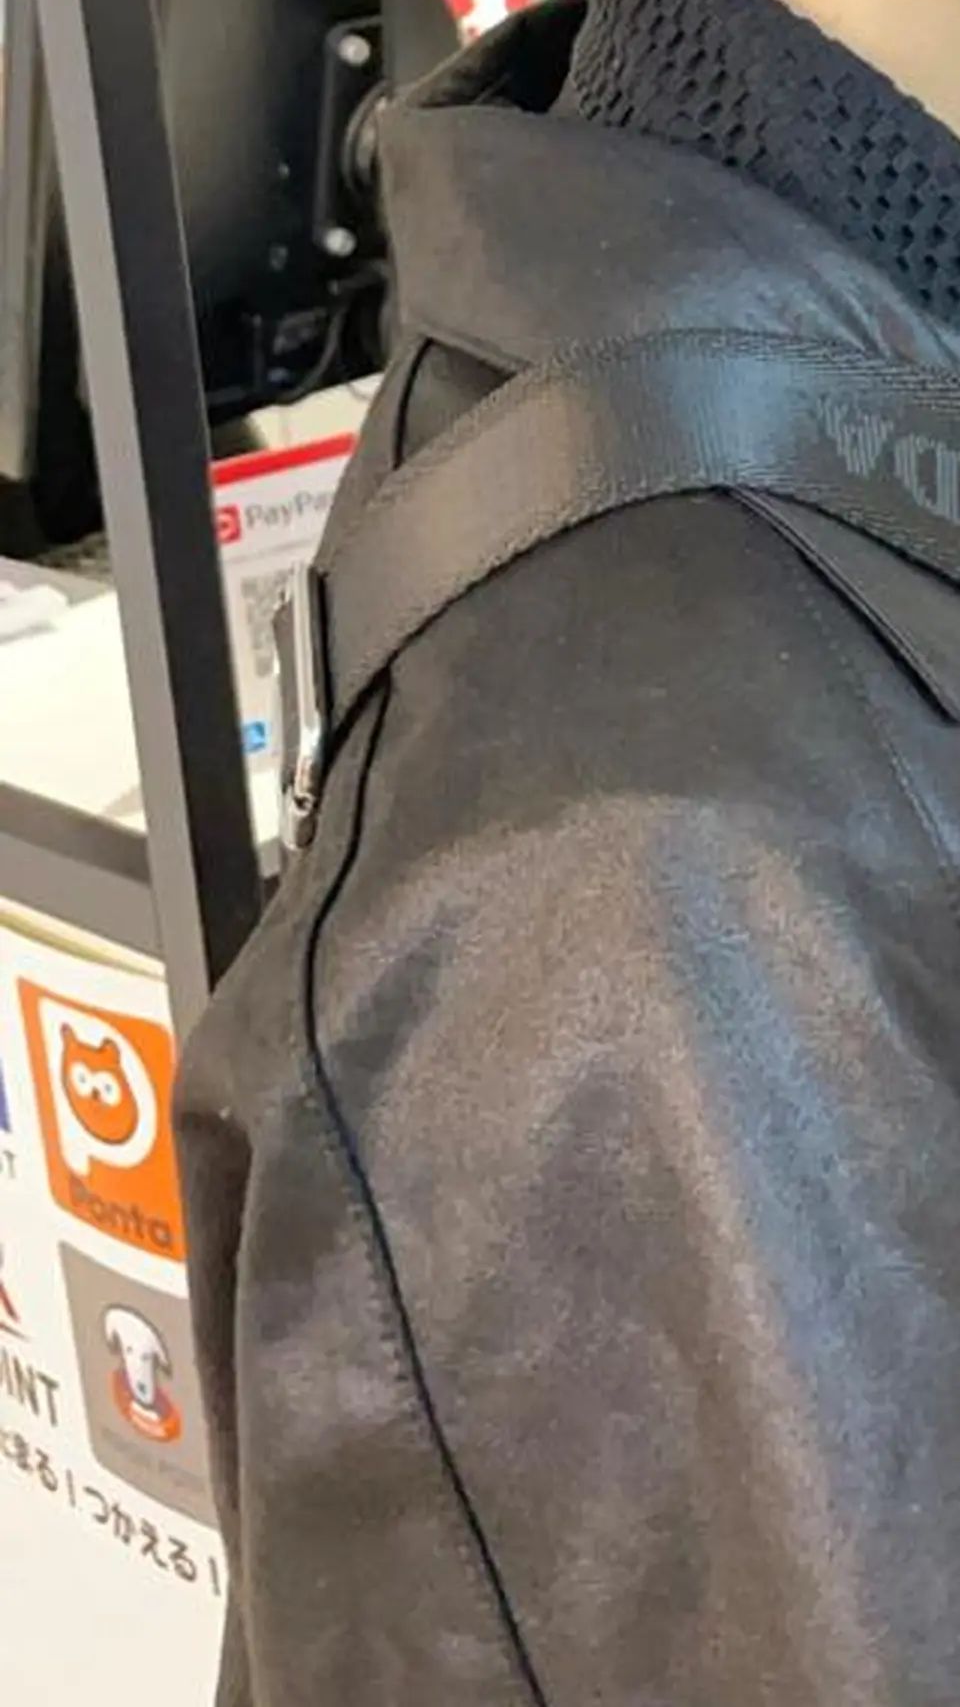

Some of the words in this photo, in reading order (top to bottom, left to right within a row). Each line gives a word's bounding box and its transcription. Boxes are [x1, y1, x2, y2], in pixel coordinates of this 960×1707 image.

[245, 490, 334, 530] PayPa
[69, 1175, 173, 1248] Ponta
[0, 1346, 59, 1426] INT
